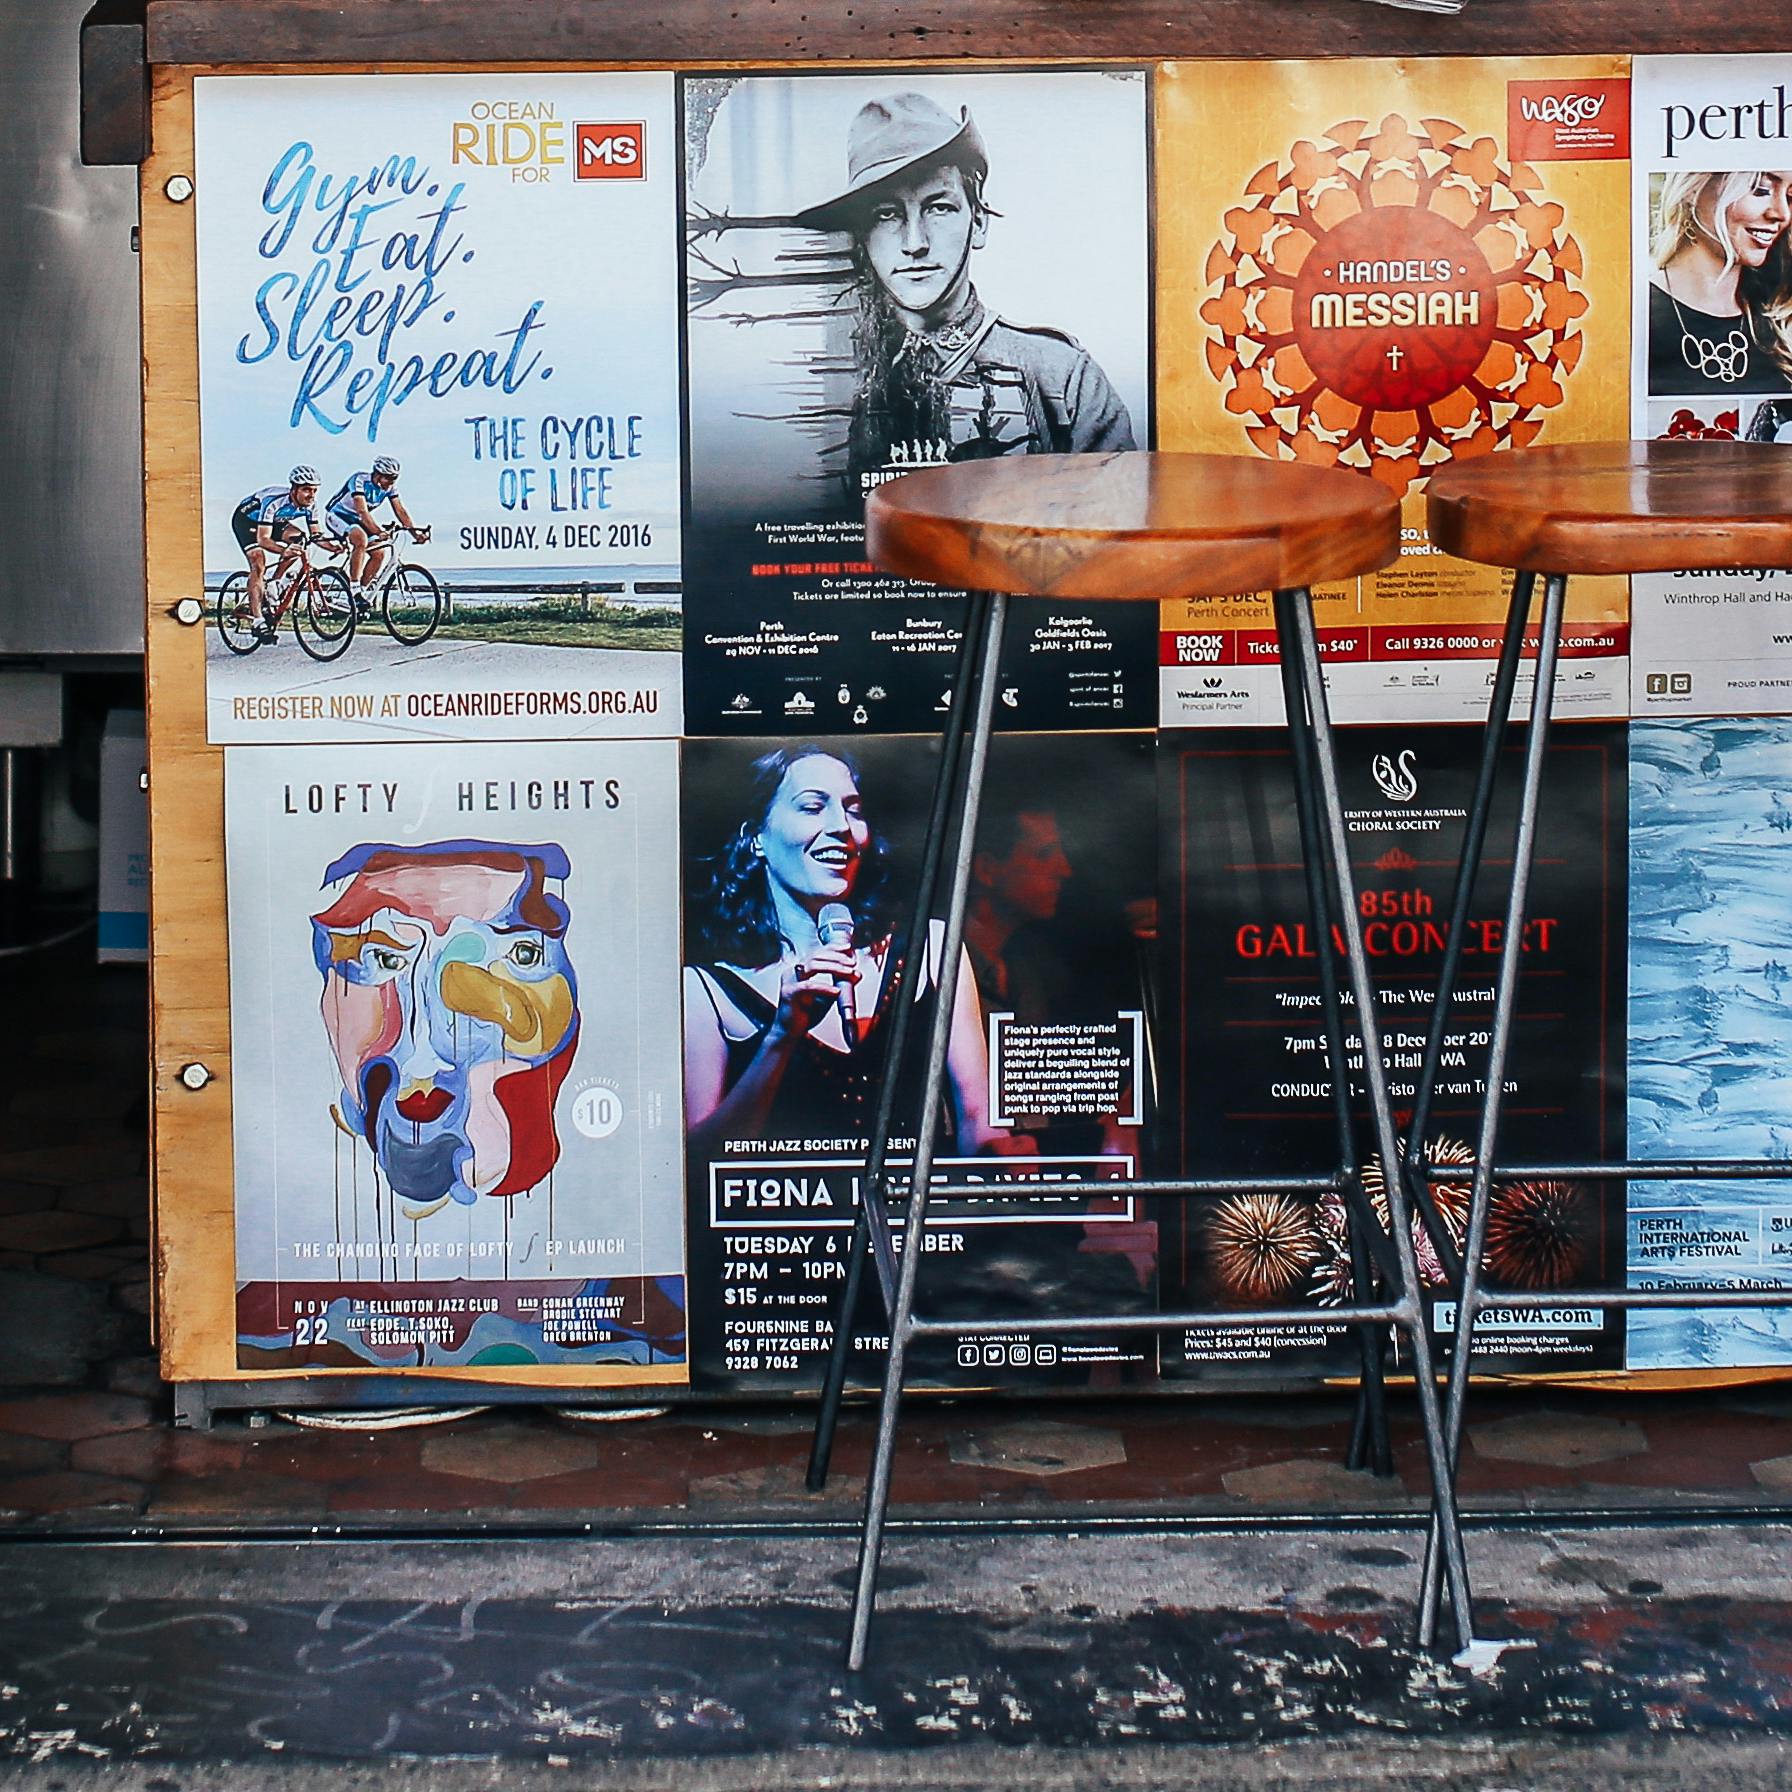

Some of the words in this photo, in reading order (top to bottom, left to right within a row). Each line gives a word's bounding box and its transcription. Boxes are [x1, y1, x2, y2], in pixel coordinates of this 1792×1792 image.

[471, 101, 555, 121] OCEAN
[452, 122, 566, 166] RIDE
[581, 135, 638, 166] MS
[511, 167, 551, 184] FOR
[258, 140, 438, 260] Gym.
[336, 182, 476, 292] Eat.
[1339, 259, 1452, 284] HANDEL'S
[235, 257, 455, 367] Sleep.
[1310, 291, 1480, 329] MESSIAH
[290, 300, 554, 443] Repeat.
[465, 415, 526, 461] THE
[540, 415, 644, 460] CYCLE
[499, 467, 538, 512] OF
[549, 466, 613, 512] LIFE
[460, 527, 541, 552] SUNDAY,
[546, 527, 558, 548] 4
[562, 525, 602, 548] DEC
[608, 523, 652, 548] 2016
[1664, 592, 1720, 605] Winthrop
[1723, 592, 1746, 603] Hall
[1749, 591, 1771, 603] and
[1176, 636, 1223, 649] BOOK
[1385, 638, 1409, 650] Call
[1413, 637, 1444, 650] 9326
[1447, 637, 1478, 649] 0000
[1179, 649, 1220, 661] NOW
[233, 695, 327, 721] REGISTER
[330, 695, 372, 719] NOW
[375, 694, 401, 717] AT
[406, 688, 658, 717] OCEANRIDEFORMS.ORG.AU
[284, 783, 399, 815] LOFTY
[457, 780, 622, 811] HEIGHTS
[1348, 821, 1393, 831] CHORAL
[1395, 820, 1441, 831] SOCIETY
[1359, 889, 1433, 917] 85th
[1077, 1036, 1095, 1045] and
[577, 1098, 611, 1125] $10
[724, 1139, 767, 1153] PERTH
[769, 1139, 802, 1152] JAZZ
[804, 1138, 860, 1152] SOCIETY
[724, 1177, 834, 1208] FIONA
[1639, 1219, 1683, 1231] PERTH
[545, 1240, 563, 1255] EP
[569, 1238, 625, 1254] LAUNCH
[724, 1236, 815, 1254] TUESDAY
[825, 1237, 837, 1253] 6
[1639, 1231, 1749, 1244] INTERNATIONAL
[1640, 1245, 1676, 1258] ARTS
[1680, 1245, 1741, 1257] FESTIVAL
[724, 1262, 768, 1280] 7PM
[724, 1287, 757, 1305] $15
[762, 1295, 774, 1305] AT
[777, 1294, 796, 1304] THE
[799, 1294, 828, 1304] DOOR
[294, 1300, 329, 1314] NOV
[369, 1299, 434, 1314] ELLINGTON
[437, 1299, 467, 1313] JAZZ
[468, 1298, 499, 1312] CLUB
[296, 1318, 329, 1345] 22
[370, 1331, 425, 1345] SOLOMON
[428, 1330, 455, 1344] PITT
[725, 1356, 760, 1370] 9328
[765, 1355, 798, 1369] 7062
